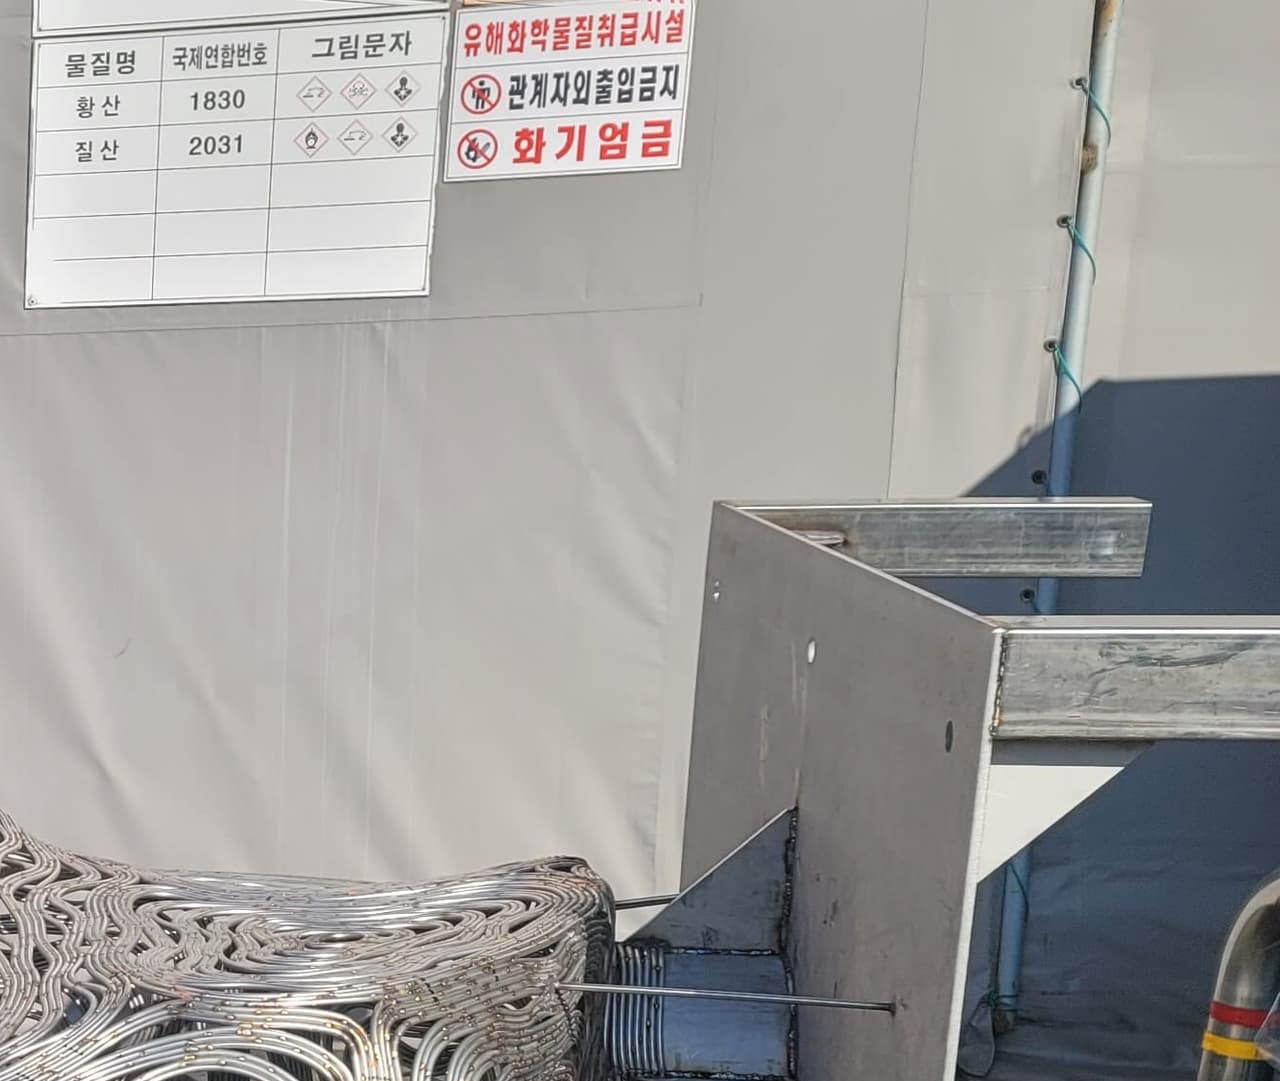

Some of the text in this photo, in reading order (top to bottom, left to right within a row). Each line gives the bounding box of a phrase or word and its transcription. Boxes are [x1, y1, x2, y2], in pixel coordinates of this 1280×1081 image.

[65, 30, 413, 78] 물질명 국제연합번호 그림문자
[463, 9, 685, 57] 유해화학물질취급시설
[190, 89, 246, 111] 1830
[508, 64, 680, 110] 관계자외출입금지
[189, 134, 244, 156] 2031
[512, 119, 673, 164] 화기엄금
